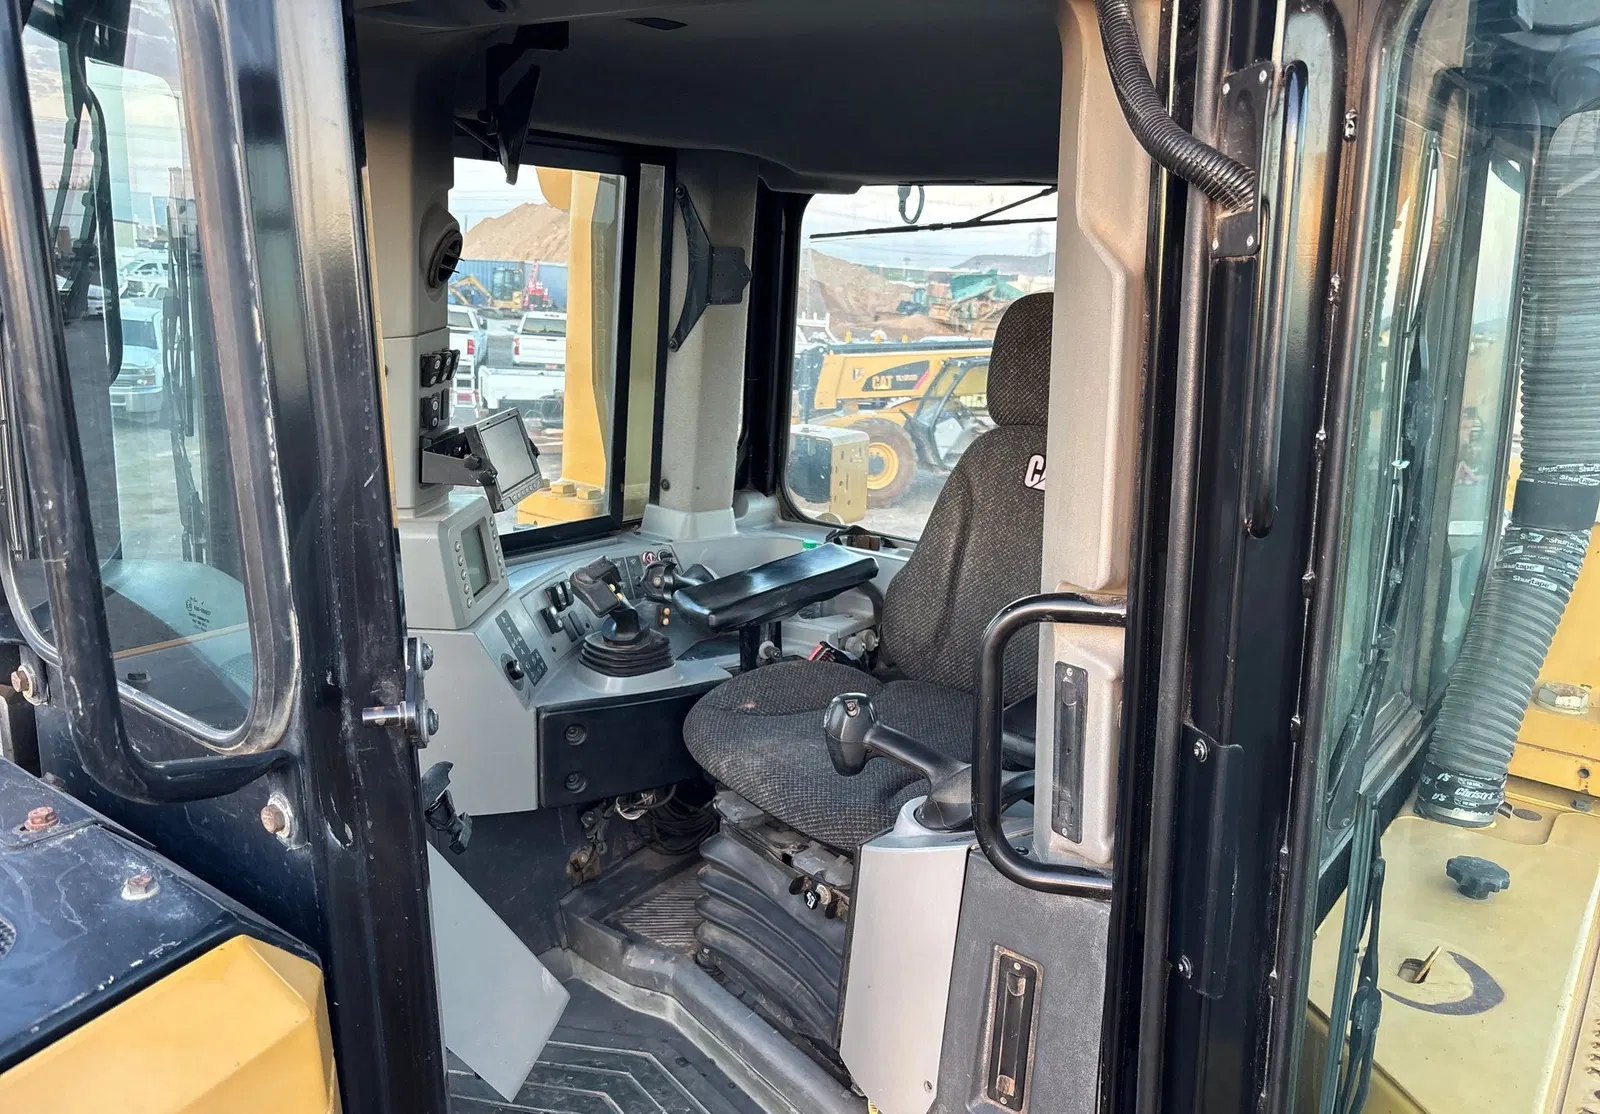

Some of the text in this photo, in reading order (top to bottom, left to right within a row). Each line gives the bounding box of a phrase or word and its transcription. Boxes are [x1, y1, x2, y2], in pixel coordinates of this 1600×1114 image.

[872, 375, 893, 390] CAT
[1512, 574, 1550, 588] Shurtape
[1455, 787, 1495, 800] Christy's
